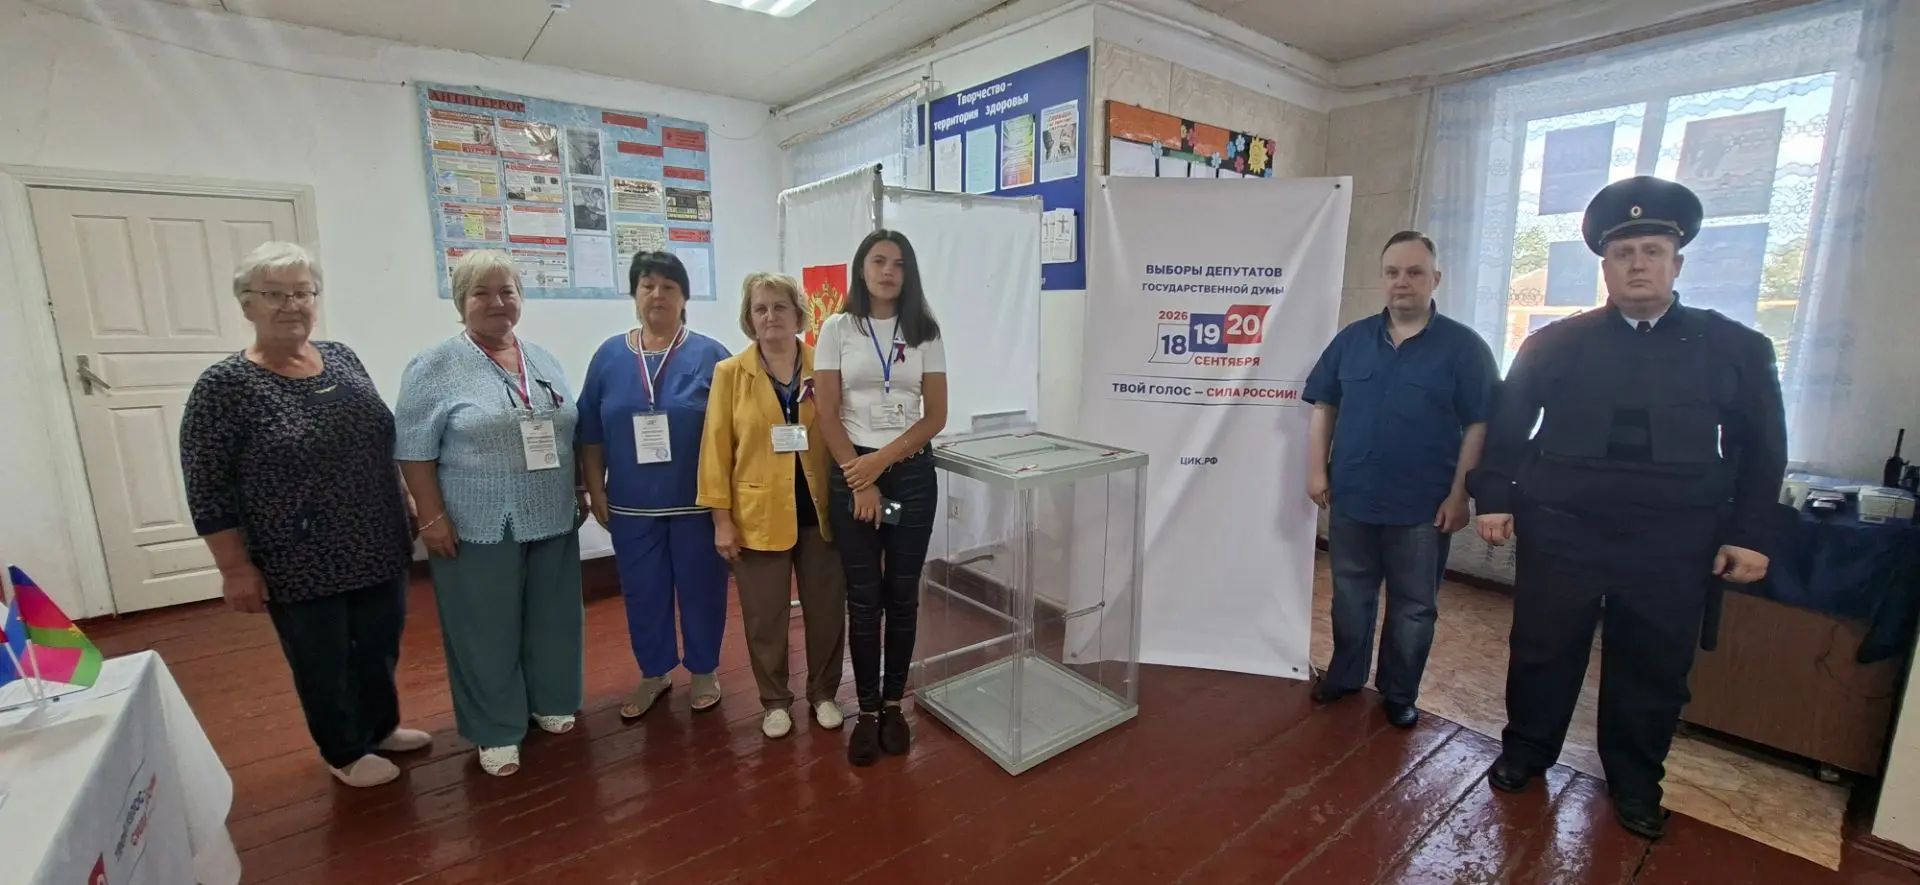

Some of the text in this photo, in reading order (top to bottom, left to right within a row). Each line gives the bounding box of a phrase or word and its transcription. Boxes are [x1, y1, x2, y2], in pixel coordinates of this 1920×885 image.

[957, 81, 1006, 106] Творчество
[934, 93, 1029, 131] территория здоровья
[1146, 264, 1283, 278] ВЫБОРЫ ДЕПУТАТОВ
[1142, 282, 1285, 296] ГОСУДАРСТВЕННОЙ ДУМЫ
[1158, 310, 1189, 321] 2026
[1161, 314, 1260, 355] 18 19 20
[1194, 355, 1261, 367] СЕНТЯБРЯ
[1112, 382, 1146, 394] ТВОЙ
[1149, 384, 1192, 396] ГОЛОС
[1206, 387, 1241, 398] СИЛА
[1242, 388, 1297, 399] РОССИИ!
[1180, 456, 1218, 466] ЦИК.РФ
